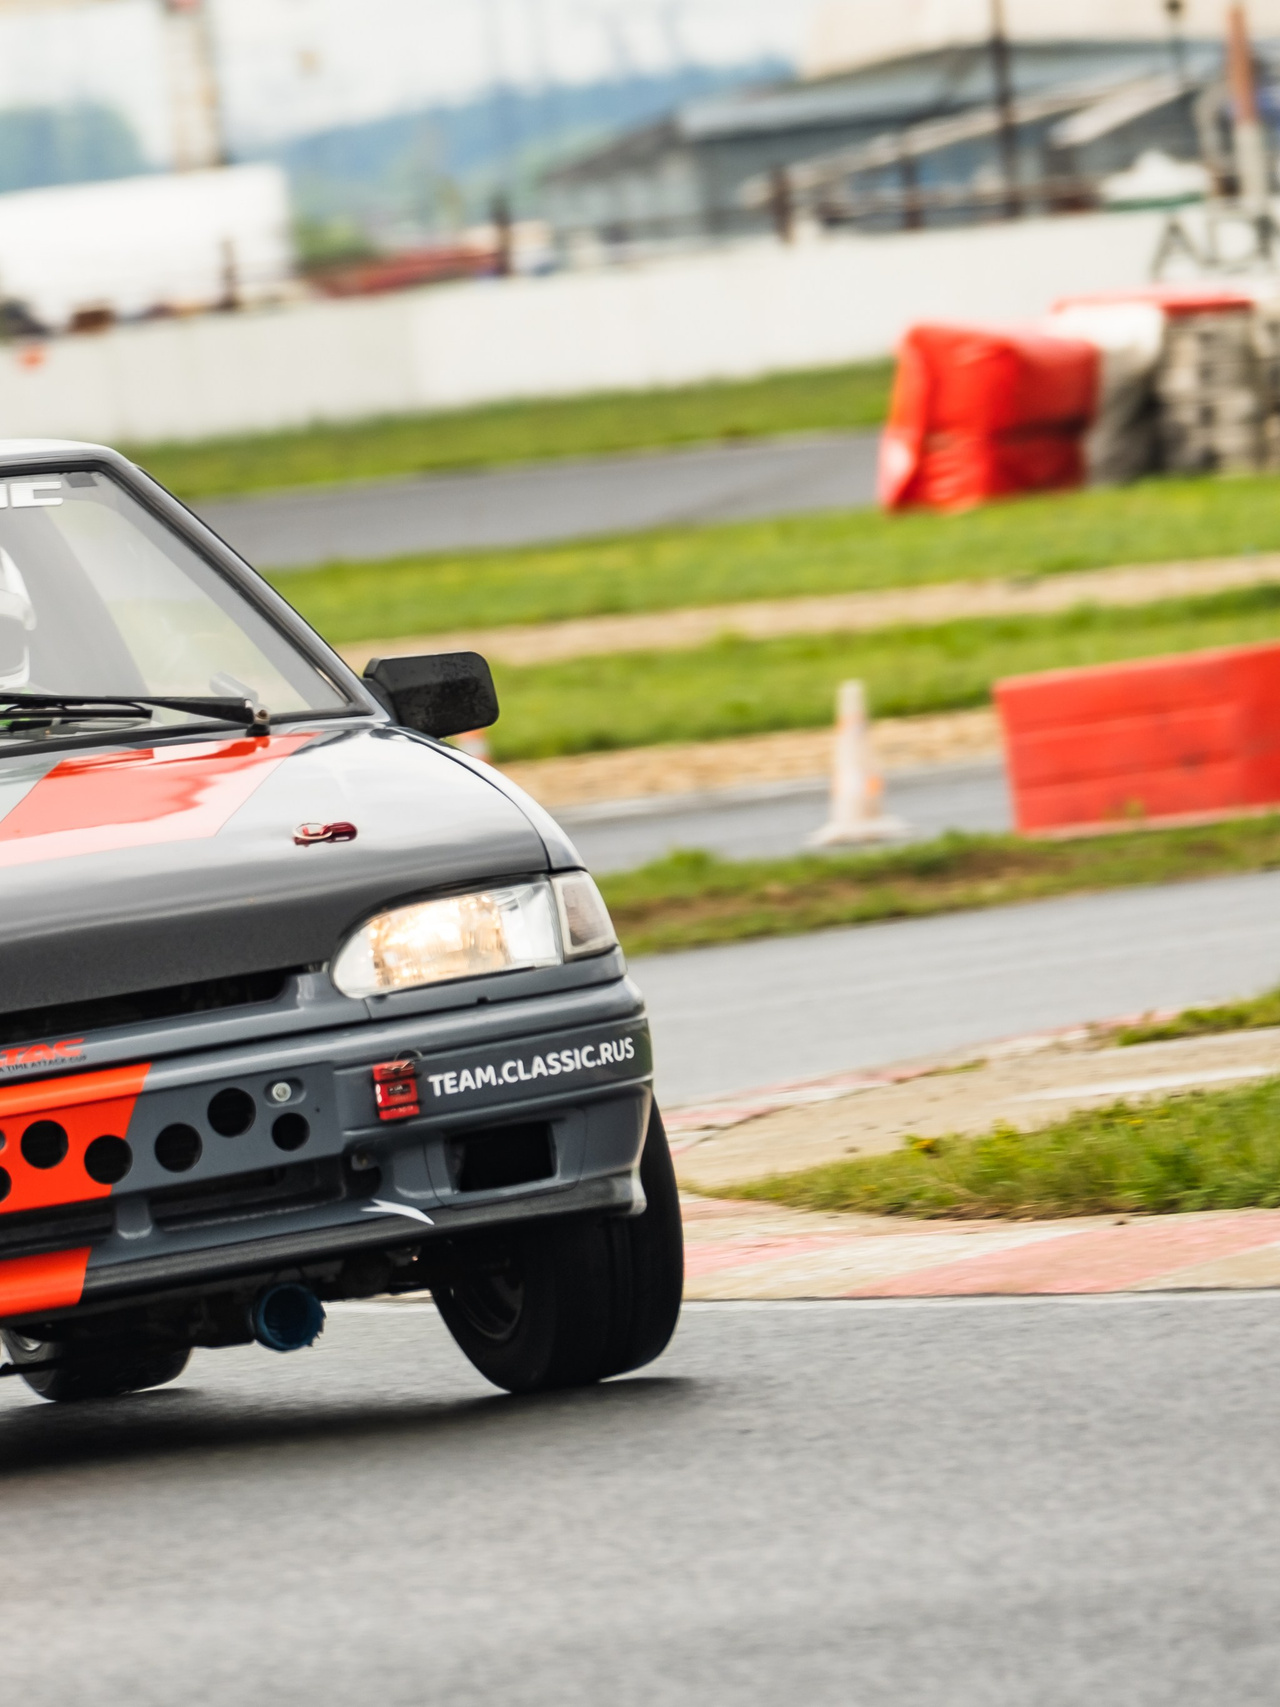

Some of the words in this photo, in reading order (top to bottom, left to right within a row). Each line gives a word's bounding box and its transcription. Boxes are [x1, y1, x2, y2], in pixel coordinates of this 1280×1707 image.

[1150, 214, 1280, 282] AD
[7, 1063, 28, 1073] TIME
[427, 1037, 635, 1097] TEAM.CLASSIC.RUS
